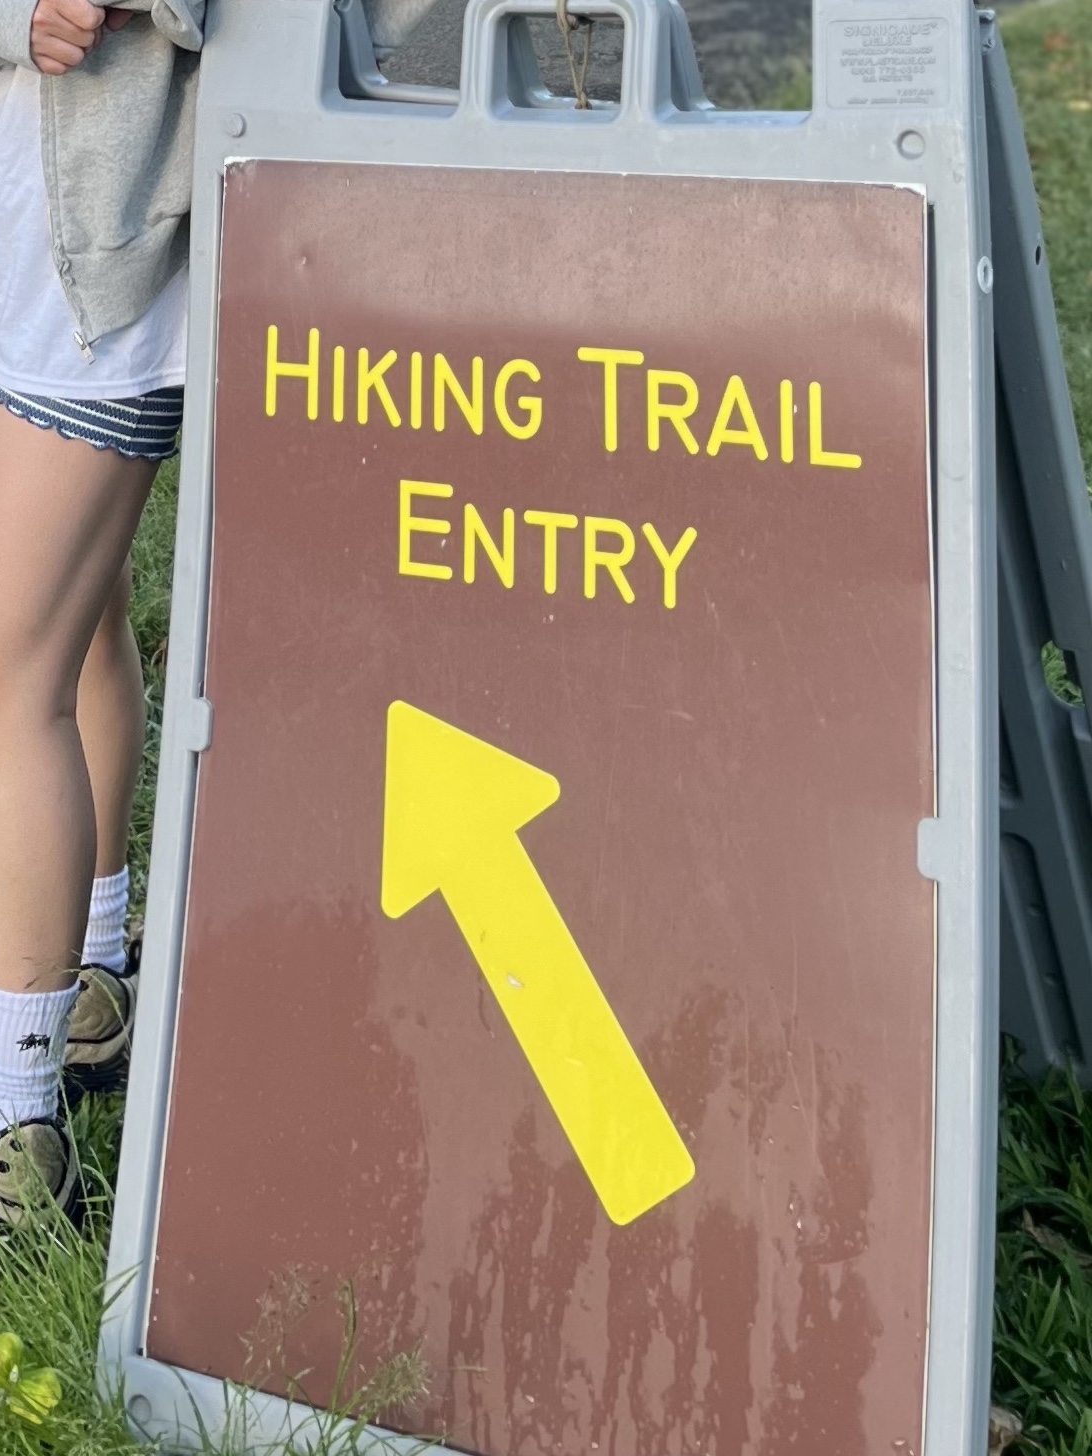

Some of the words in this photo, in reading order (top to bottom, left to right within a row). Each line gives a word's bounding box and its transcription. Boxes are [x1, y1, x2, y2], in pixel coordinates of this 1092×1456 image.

[265, 325, 543, 440] HIKING
[577, 346, 863, 470] TRAIL
[398, 479, 698, 610] ENTRY
